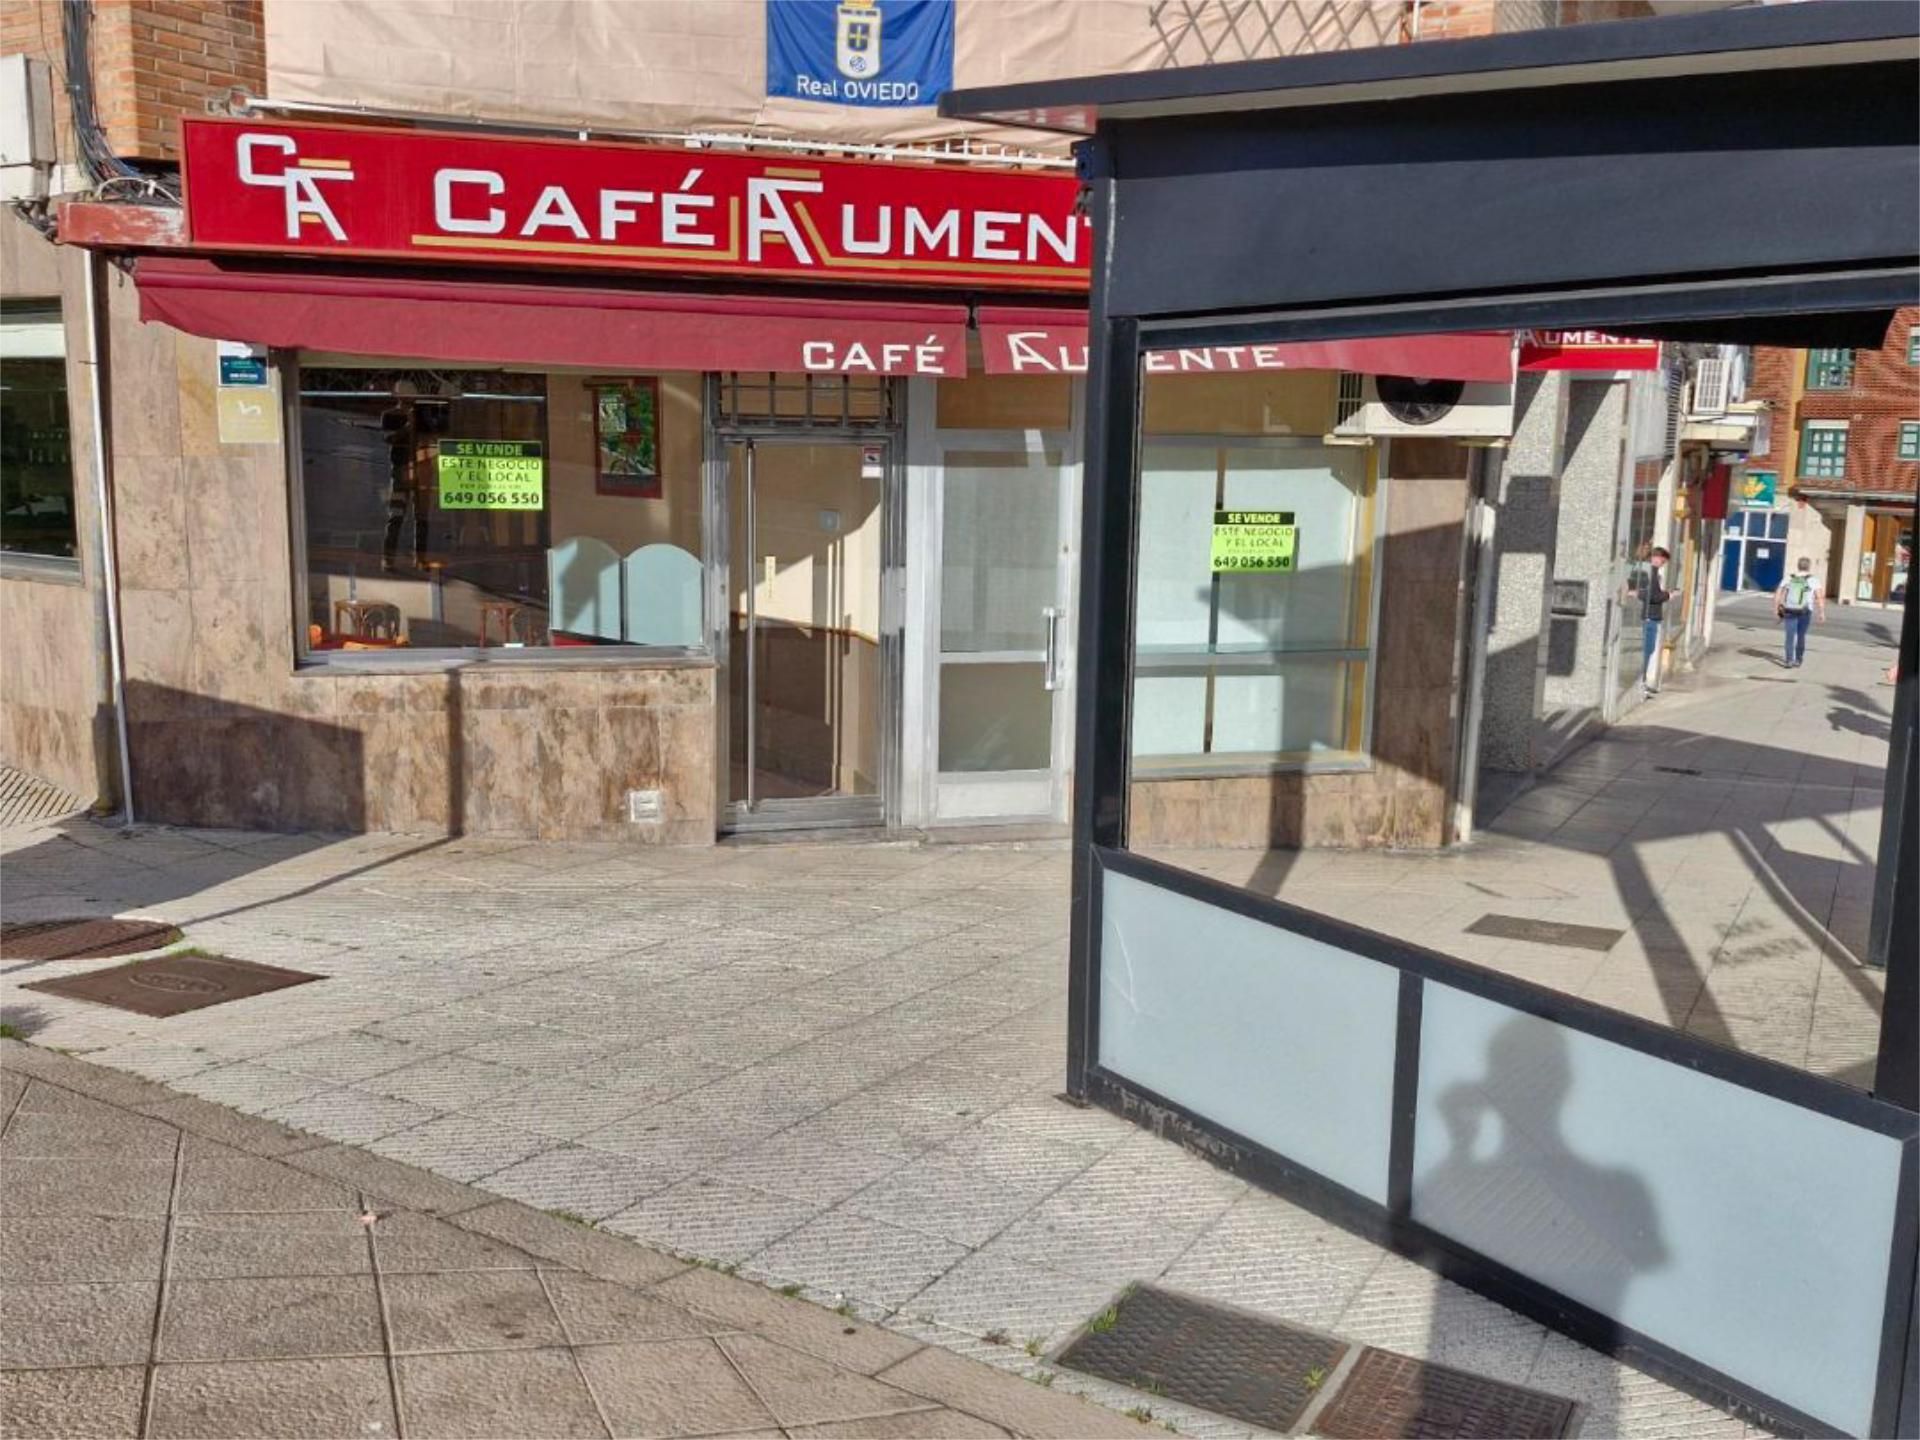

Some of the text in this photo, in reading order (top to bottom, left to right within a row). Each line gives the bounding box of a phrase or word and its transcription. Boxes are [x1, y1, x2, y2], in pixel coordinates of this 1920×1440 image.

[797, 75, 919, 100] Real OVIEDO
[434, 168, 1093, 264] CAFÉ AUMEN
[803, 331, 1285, 374] CAFÉ AUENTE
[456, 443, 523, 456] SE VENDE
[442, 458, 540, 470] ESTE NEGOCIO
[456, 471, 464, 481] Y
[488, 472, 533, 482] LOCAL
[444, 491, 540, 504] 649 056 550
[1227, 513, 1281, 523] SE VENDE
[1214, 556, 1290, 568] 649 056 550
